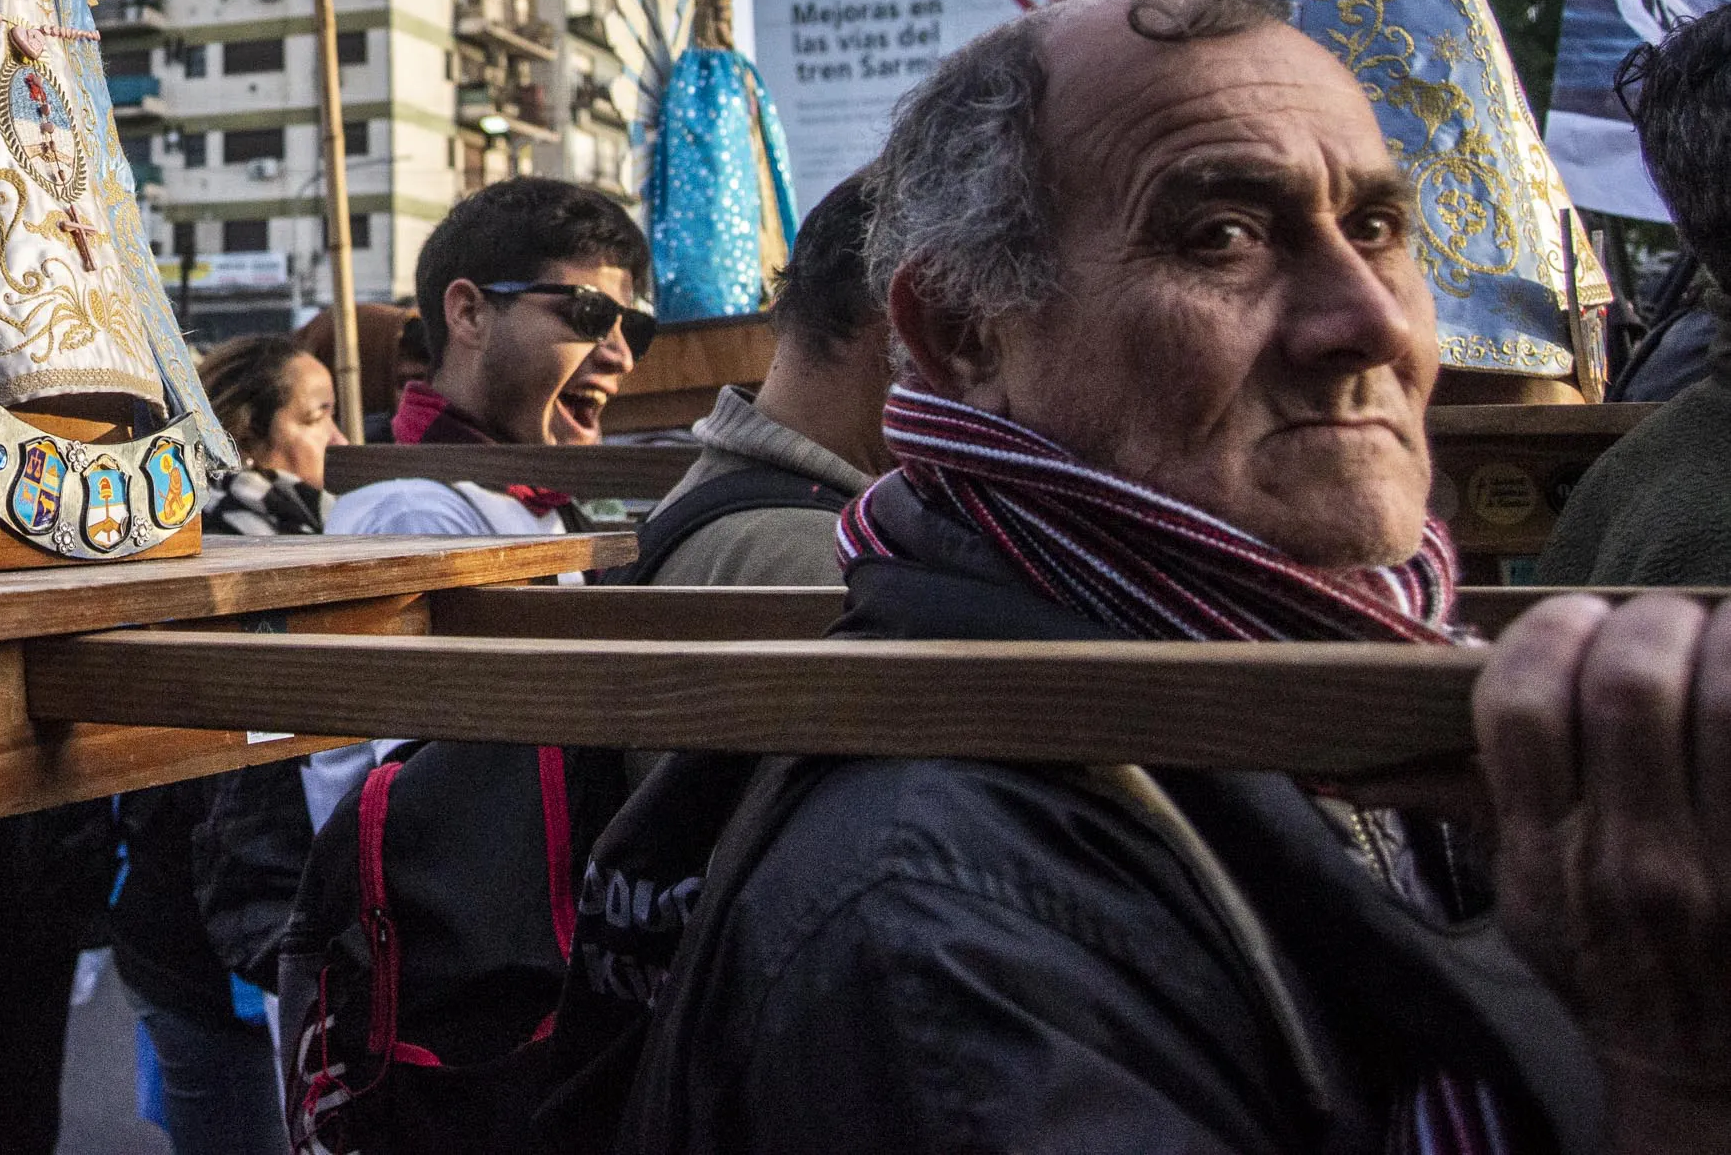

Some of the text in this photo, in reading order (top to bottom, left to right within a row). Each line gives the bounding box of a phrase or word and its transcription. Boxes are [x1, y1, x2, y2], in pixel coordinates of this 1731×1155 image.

[793, 27, 829, 54] las
[898, 19, 941, 48] del
[796, 61, 853, 85] tren
